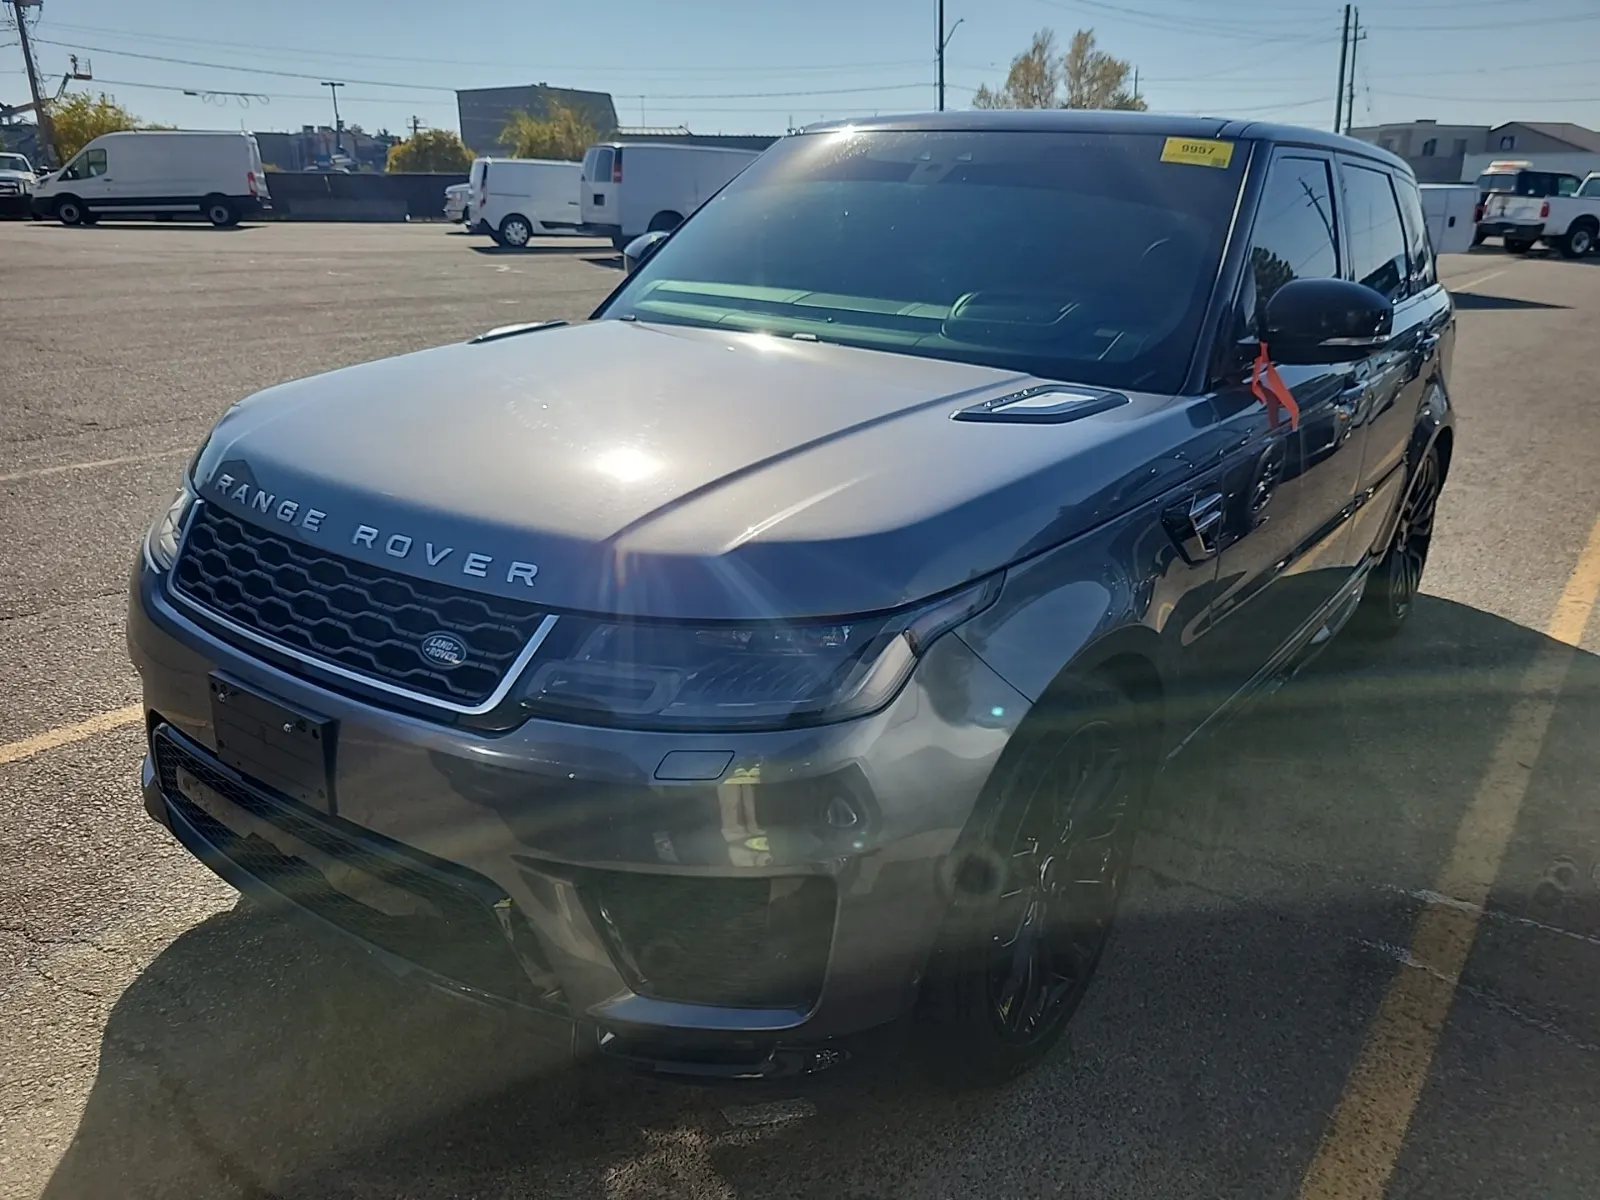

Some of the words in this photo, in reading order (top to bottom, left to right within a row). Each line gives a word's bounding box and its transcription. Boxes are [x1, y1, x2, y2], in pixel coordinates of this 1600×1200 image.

[1181, 144, 1216, 155] 9957
[214, 473, 326, 532] RANGE
[352, 524, 539, 587] ROVER
[430, 638, 453, 650] LAND
[429, 647, 458, 661] ROVER
